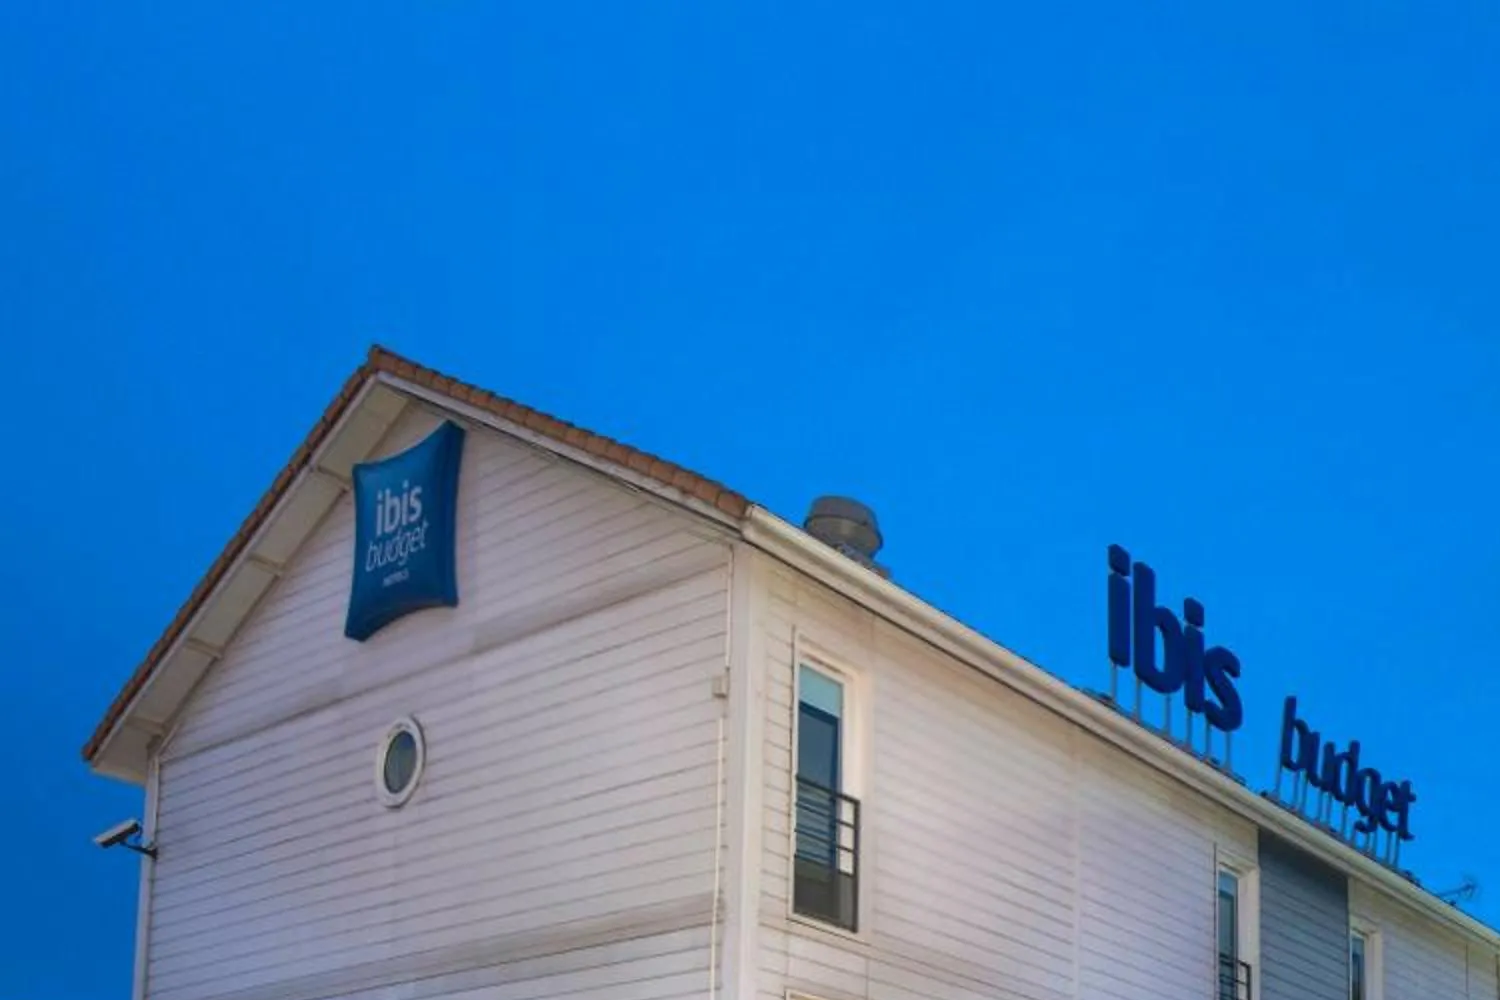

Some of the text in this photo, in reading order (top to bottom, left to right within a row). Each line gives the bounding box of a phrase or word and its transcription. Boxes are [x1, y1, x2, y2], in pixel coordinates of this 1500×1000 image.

[376, 479, 422, 537] ibis
[365, 516, 430, 572] budget
[1107, 543, 1417, 842] ibis budget
